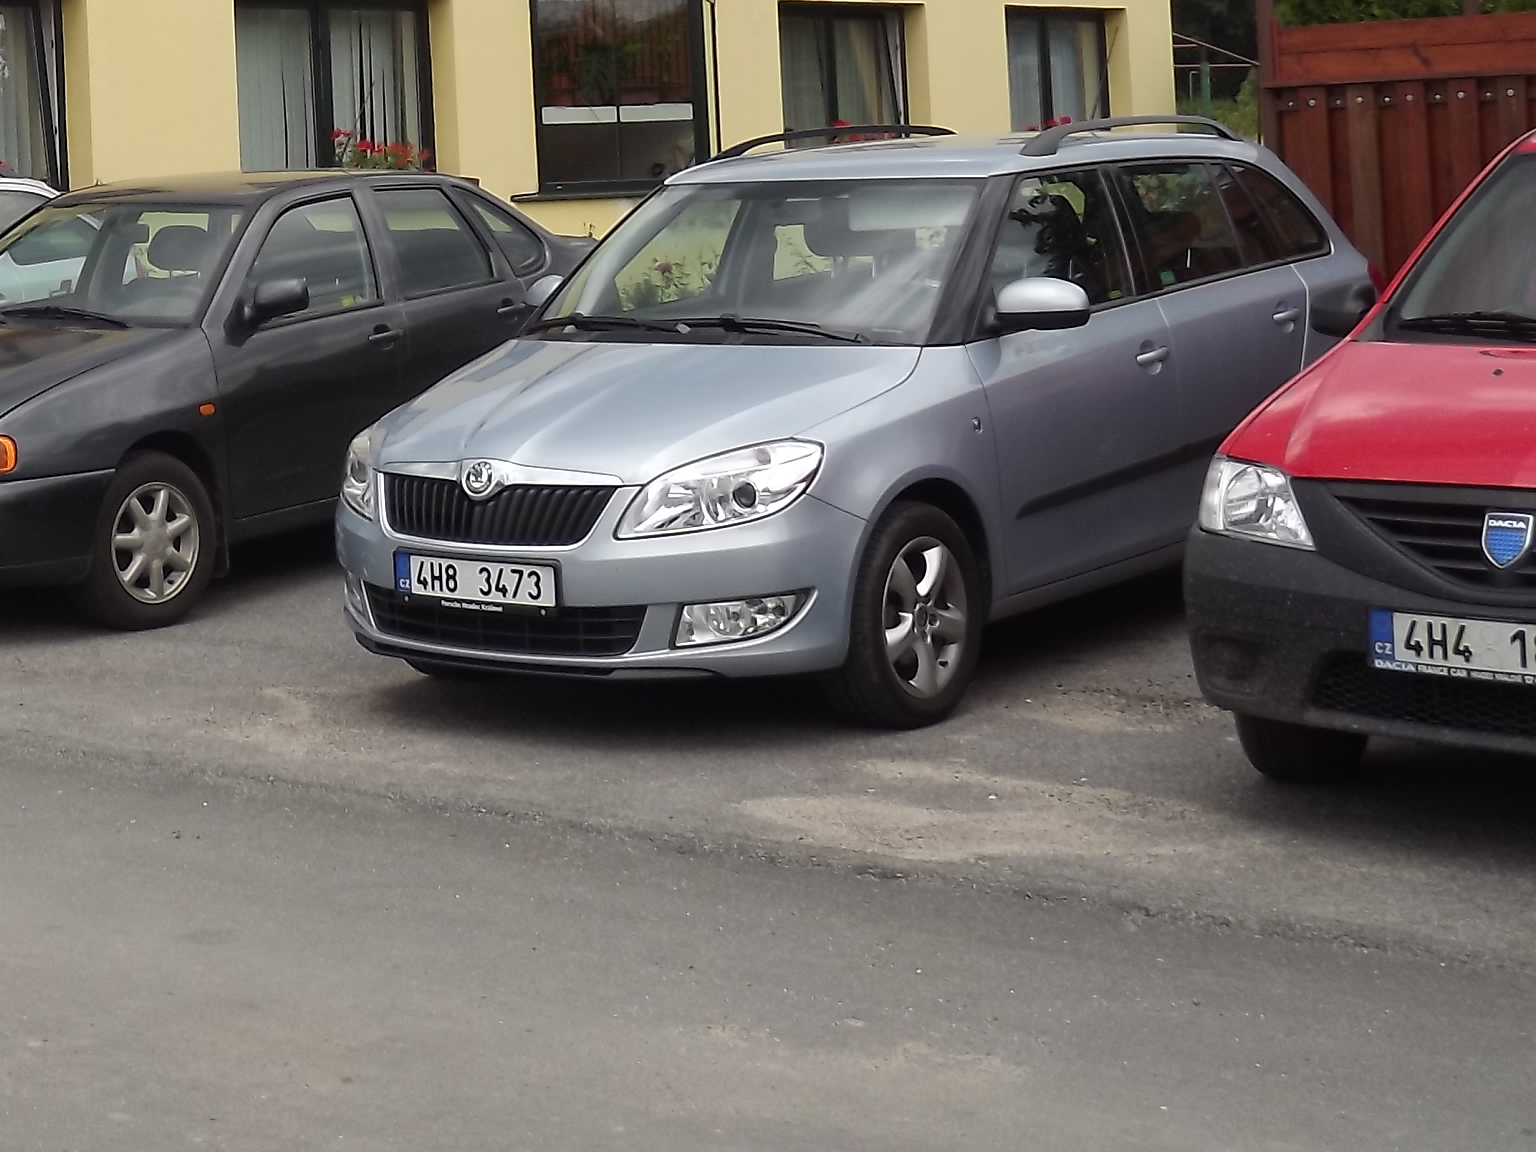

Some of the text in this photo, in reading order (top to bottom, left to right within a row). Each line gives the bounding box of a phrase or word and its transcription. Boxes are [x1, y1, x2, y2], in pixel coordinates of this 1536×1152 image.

[1488, 519, 1527, 529] DACIA
[399, 578, 410, 588] CZ
[416, 559, 541, 601] 4H8 3473
[1375, 641, 1393, 655] CZ
[1404, 619, 1536, 669] 4H4 1
[1374, 659, 1416, 672] DACIA
